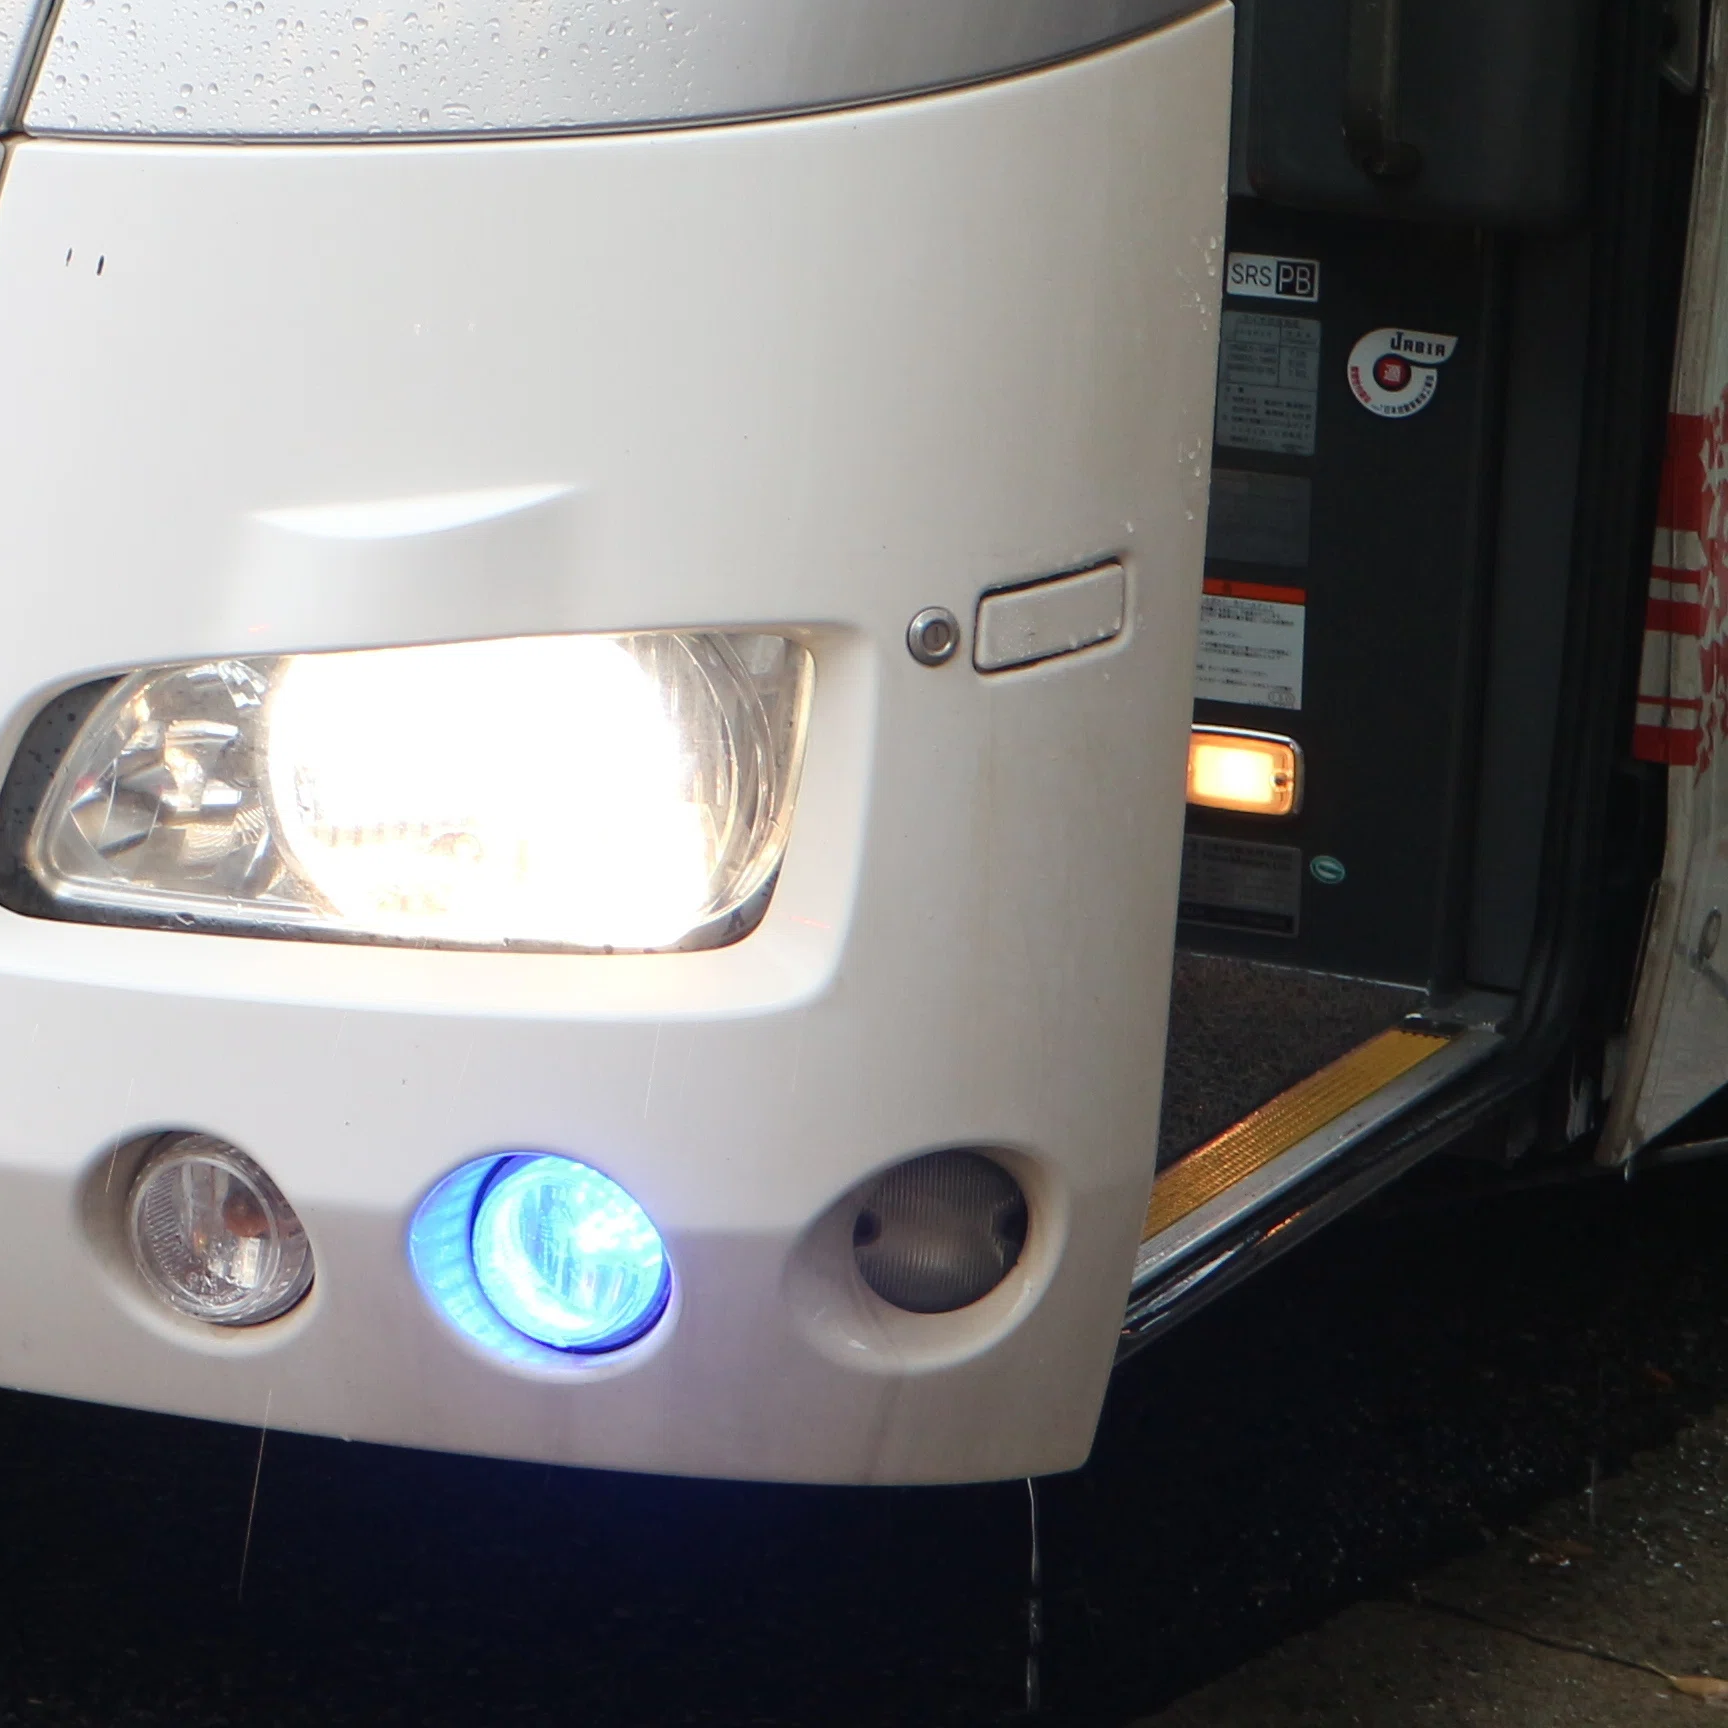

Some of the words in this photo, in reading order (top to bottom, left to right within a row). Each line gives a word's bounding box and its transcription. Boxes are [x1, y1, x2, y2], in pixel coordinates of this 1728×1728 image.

[1231, 263, 1272, 287] SRS
[1278, 264, 1311, 295] PB
[1390, 332, 1446, 357] JABIA
